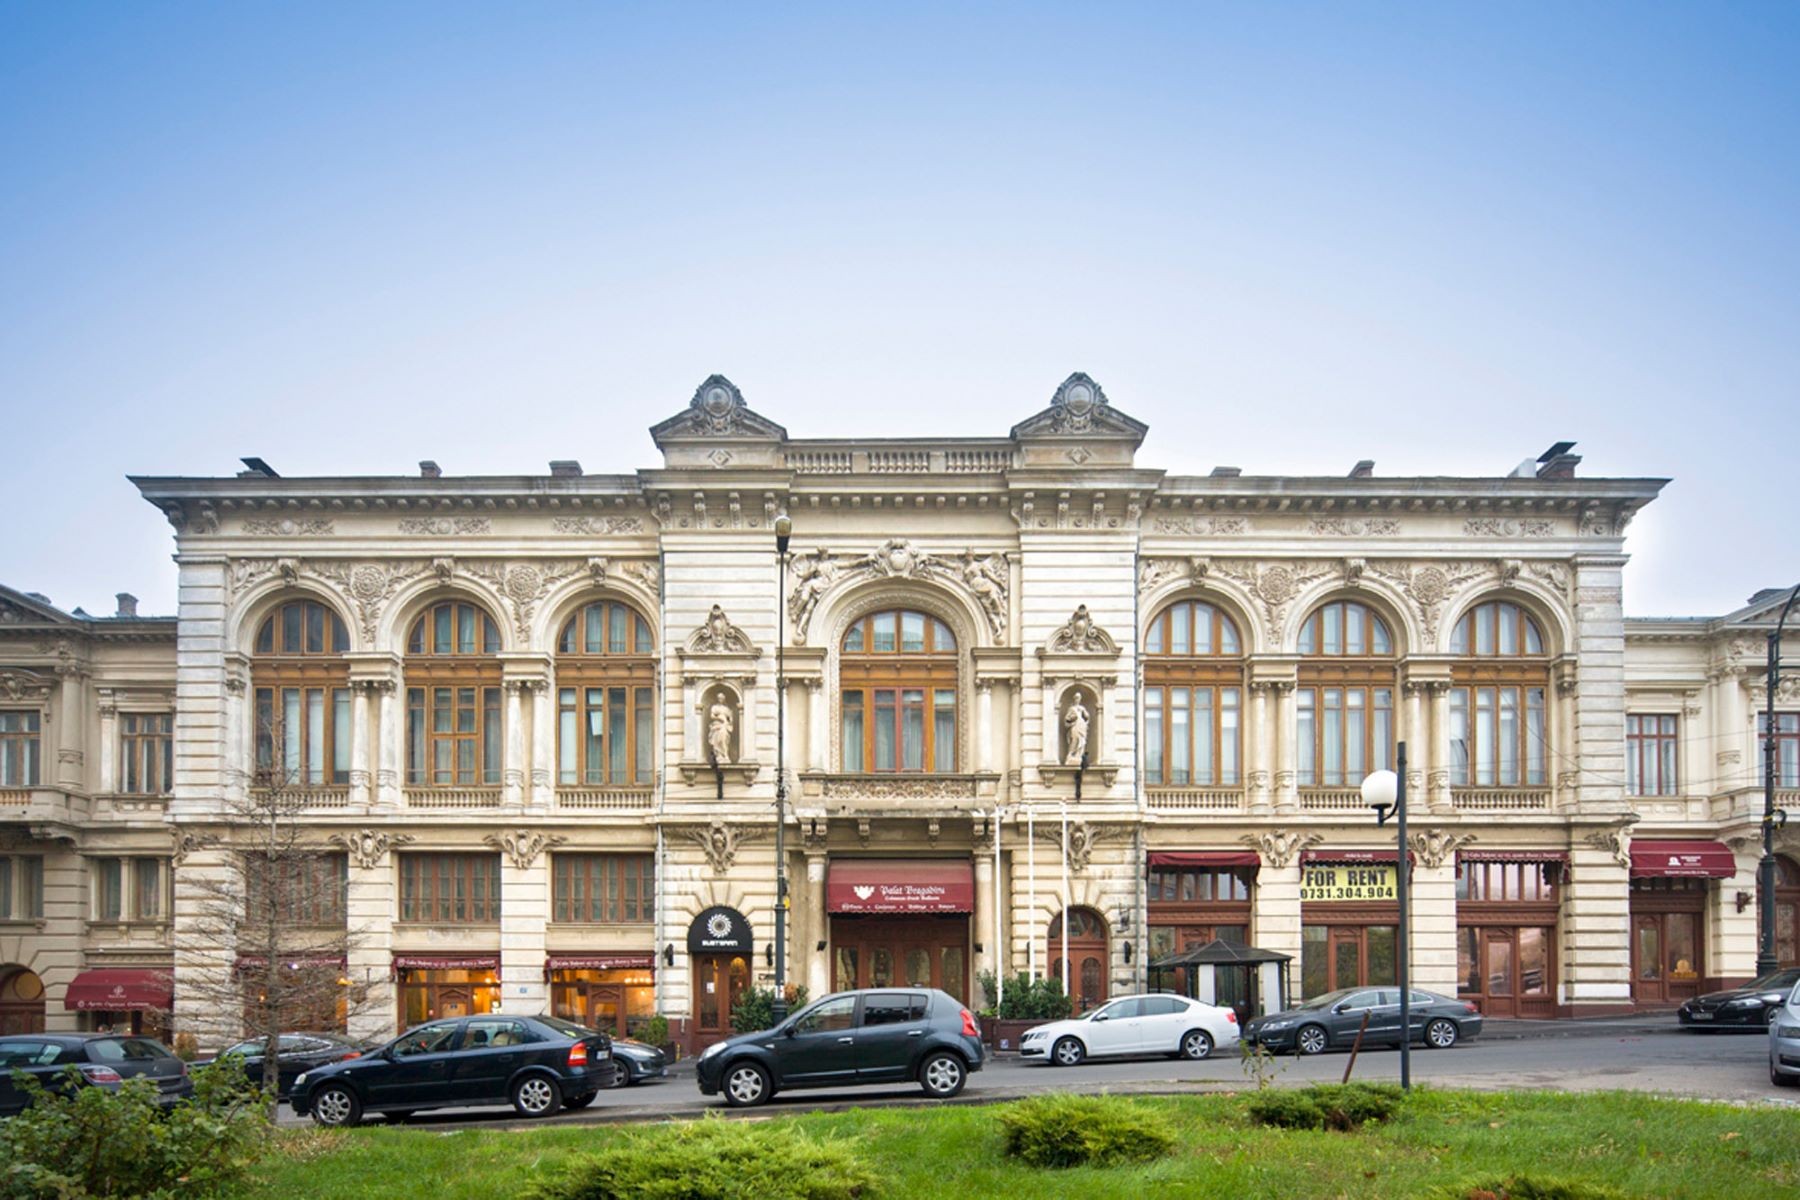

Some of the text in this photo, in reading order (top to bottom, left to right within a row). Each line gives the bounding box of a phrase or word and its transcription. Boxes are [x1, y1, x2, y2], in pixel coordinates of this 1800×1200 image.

[1306, 869, 1387, 887] FOR RENT
[1300, 887, 1393, 899] 0731.304.904
